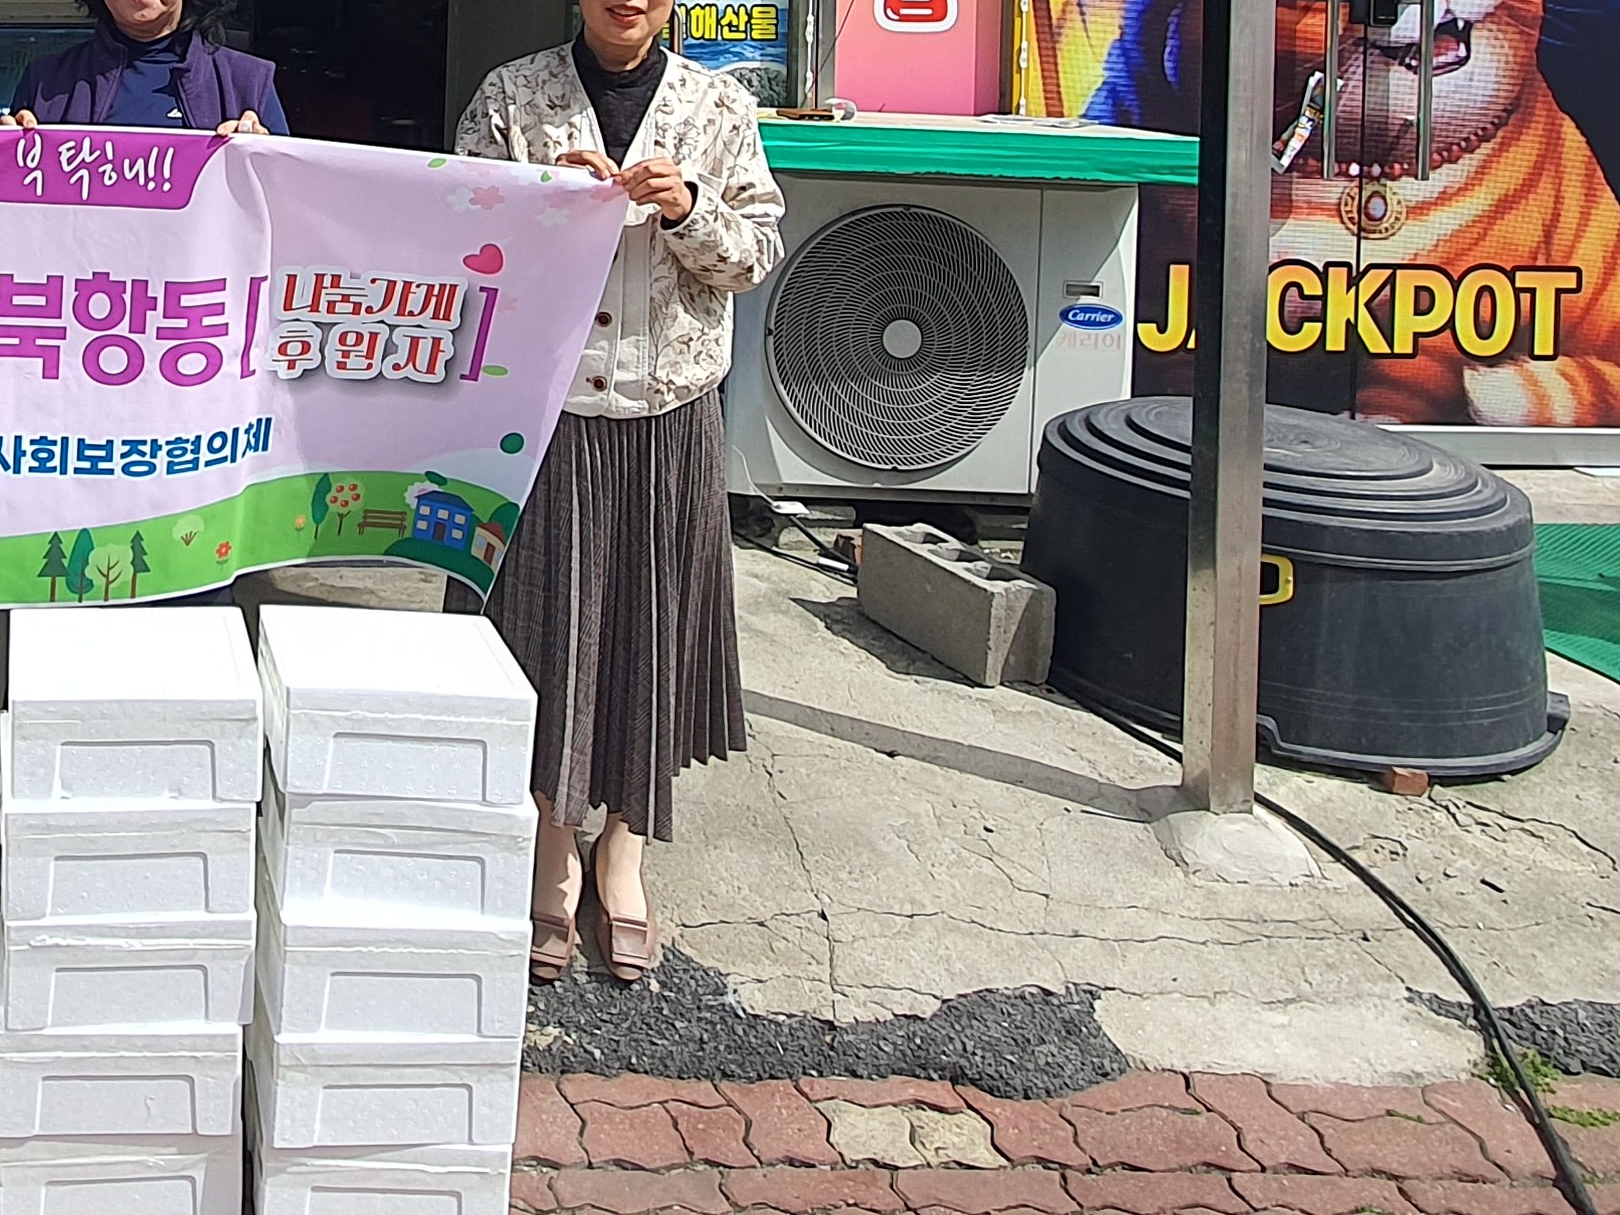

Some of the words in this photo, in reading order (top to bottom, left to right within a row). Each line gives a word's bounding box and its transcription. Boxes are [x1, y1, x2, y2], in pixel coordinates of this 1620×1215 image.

[282, 272, 460, 322] 나눔가게
[1067, 309, 1115, 323] Carrier
[1136, 263, 1579, 357] JCKPOT
[271, 330, 447, 376] 후원자
